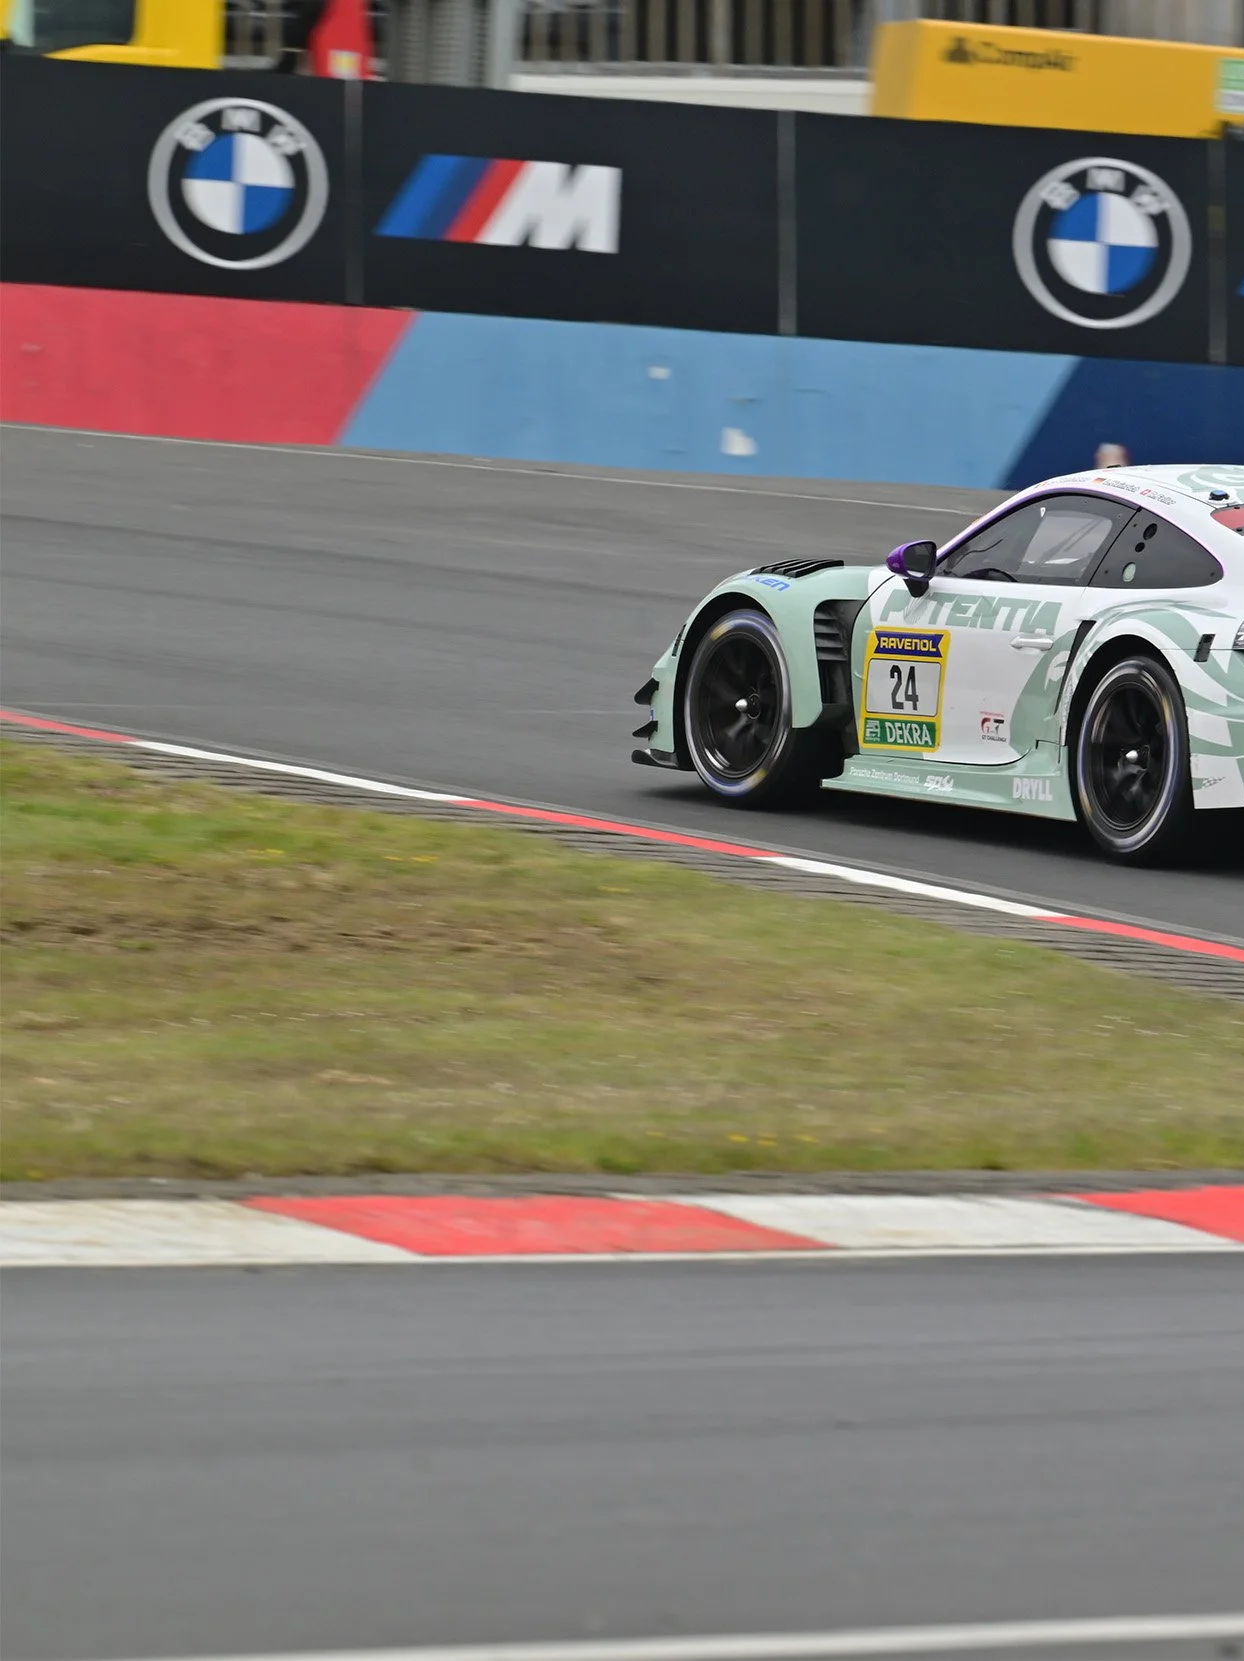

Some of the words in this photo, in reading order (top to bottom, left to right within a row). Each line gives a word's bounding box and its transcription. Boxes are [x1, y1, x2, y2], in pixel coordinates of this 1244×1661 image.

[880, 637, 937, 652] RAVENOL
[889, 664, 919, 711] 24
[885, 721, 933, 746] DEKRA
[1012, 776, 1053, 801] DRYLL
